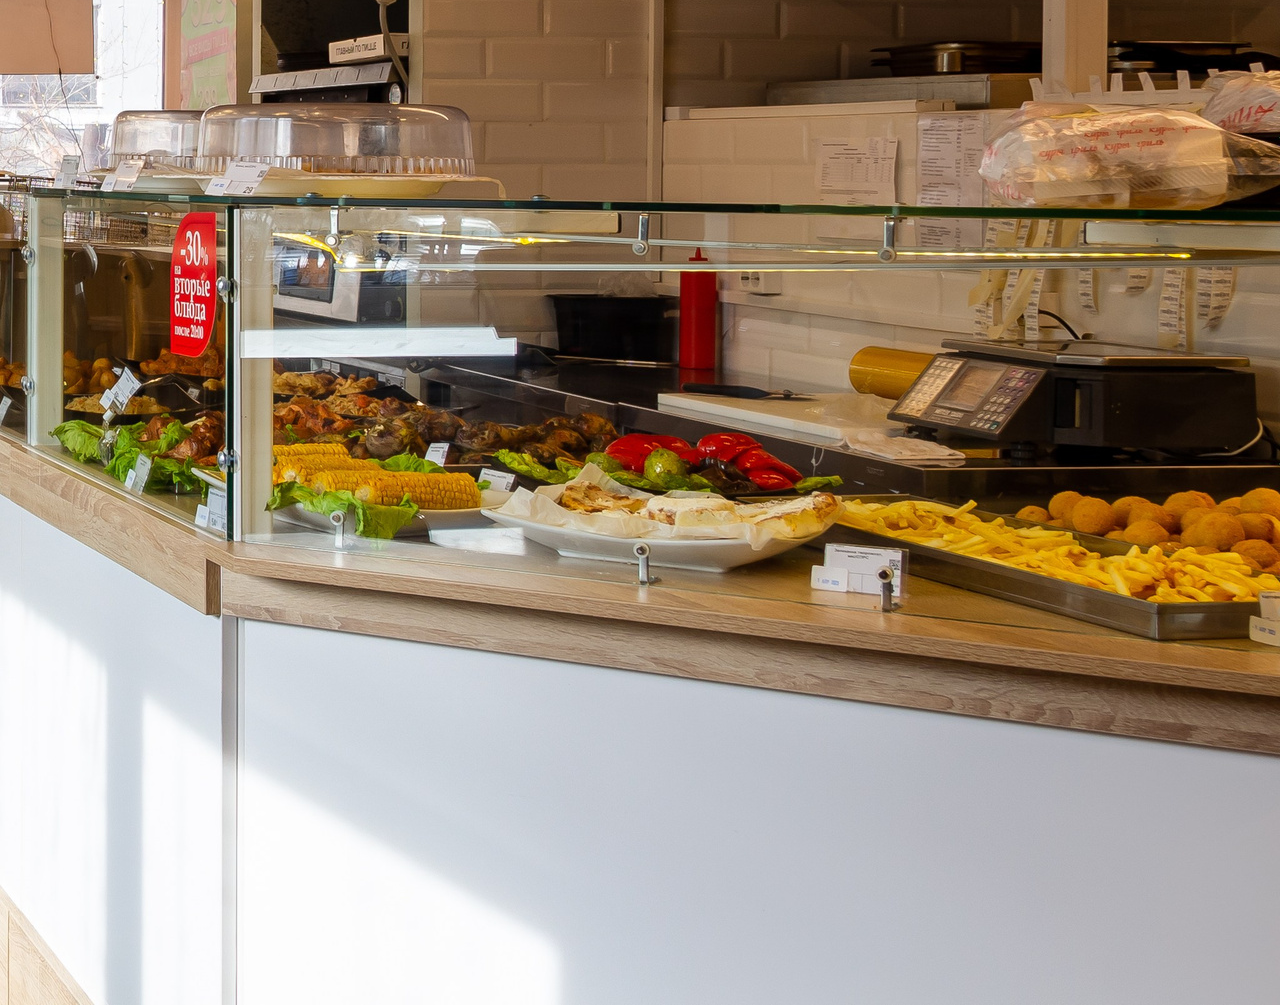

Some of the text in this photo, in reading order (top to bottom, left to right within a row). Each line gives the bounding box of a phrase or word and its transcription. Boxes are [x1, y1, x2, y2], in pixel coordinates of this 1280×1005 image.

[336, 43, 355, 56] ГЛАВНЫЙ
[355, 44, 361, 53] ПО
[180, 230, 208, 267] -30%
[174, 266, 181, 275] на
[174, 277, 210, 303] вторые
[174, 294, 206, 323] блюда
[174, 324, 204, 339] после 20:00
